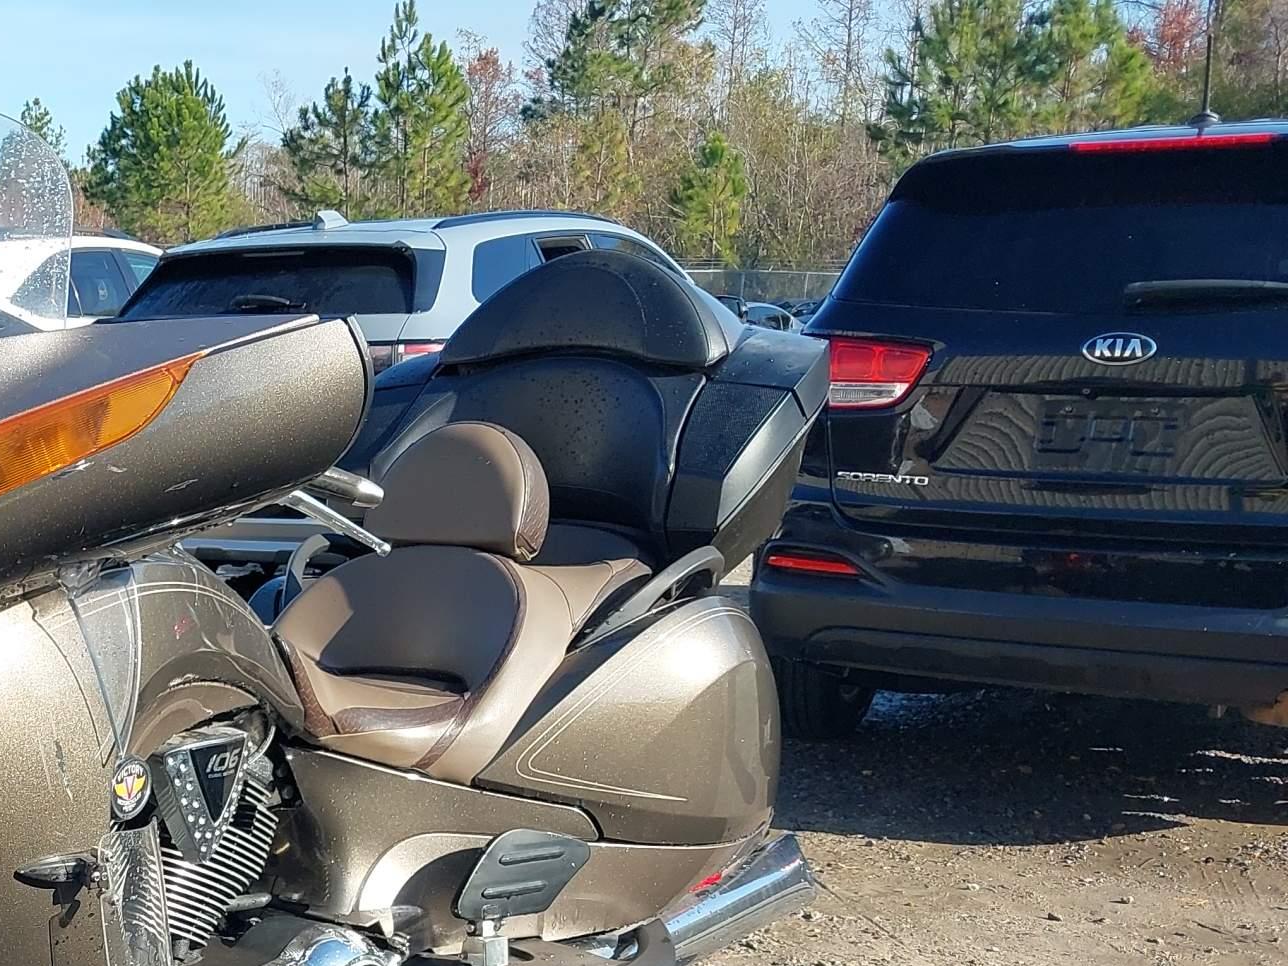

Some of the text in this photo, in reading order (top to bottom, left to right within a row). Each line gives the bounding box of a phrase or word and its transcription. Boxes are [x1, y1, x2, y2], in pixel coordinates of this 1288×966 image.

[1094, 338, 1143, 358] KIA
[836, 471, 929, 486] SORENTO
[205, 747, 241, 774] 106
[117, 763, 144, 783] VICTORY
